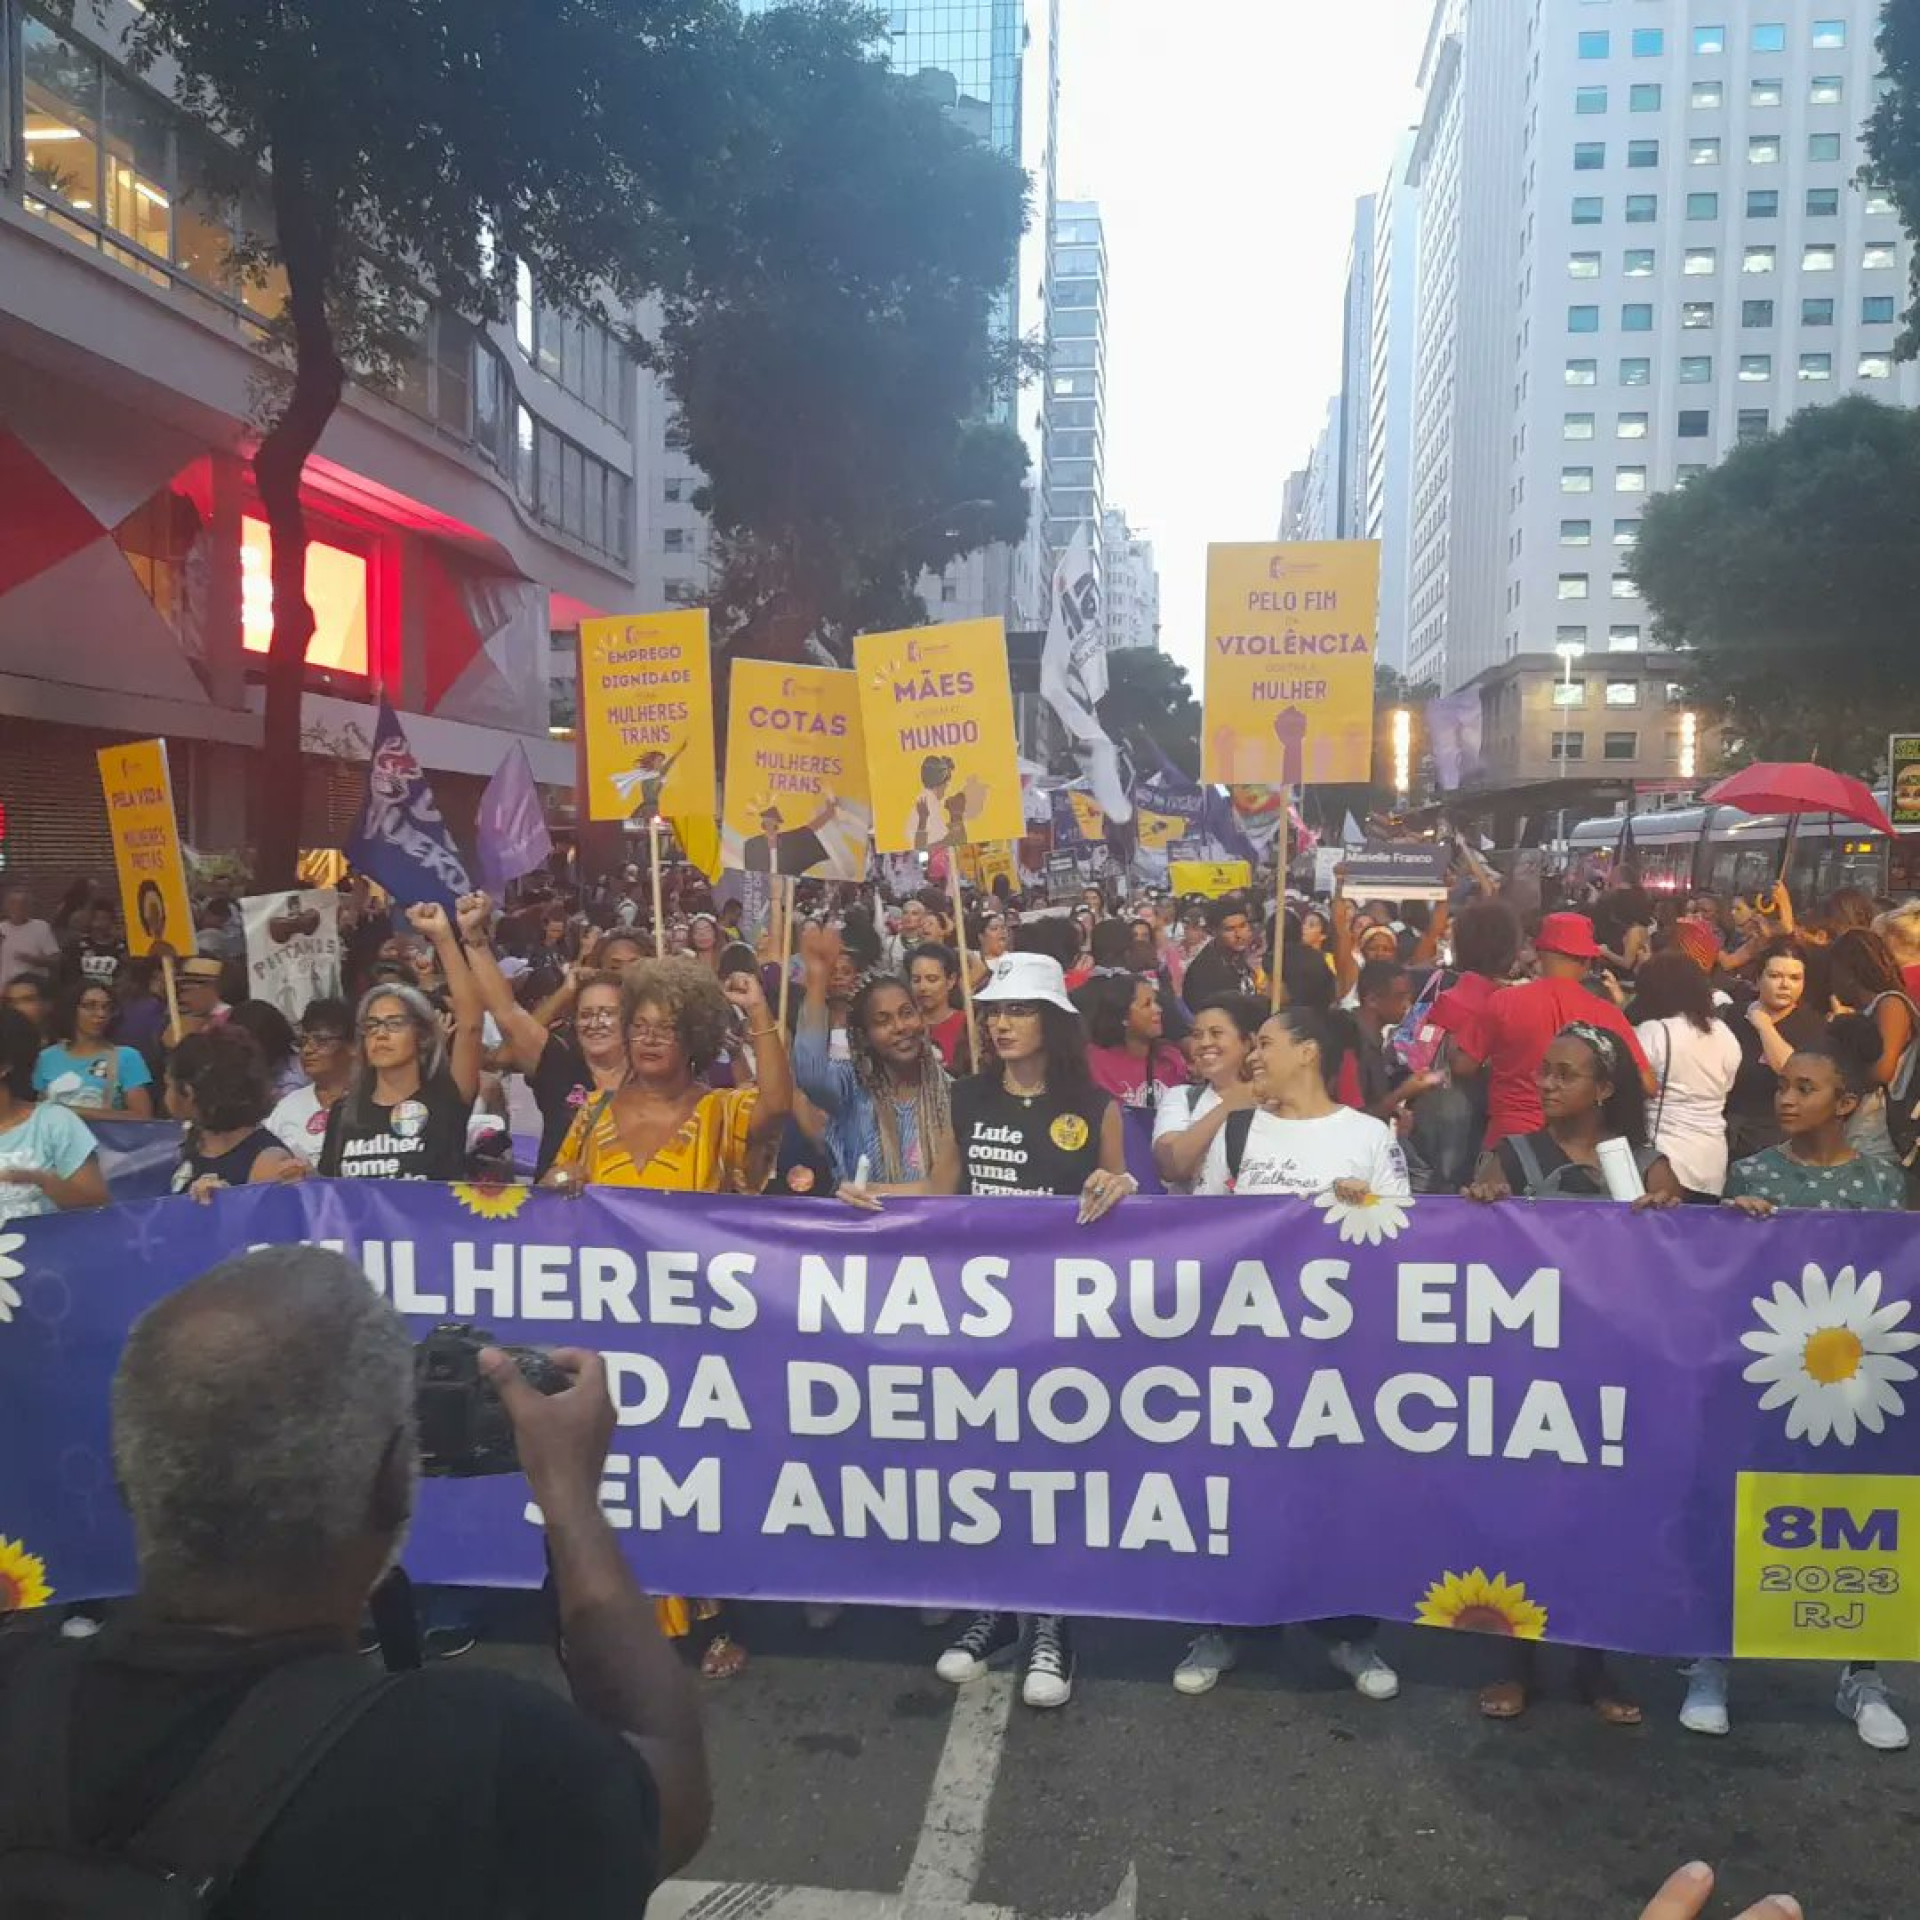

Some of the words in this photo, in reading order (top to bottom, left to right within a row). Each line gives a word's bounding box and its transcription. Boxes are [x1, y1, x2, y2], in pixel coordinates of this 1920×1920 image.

[1248, 591, 1297, 611] PELO
[1304, 590, 1337, 611] FIM
[1216, 628, 1369, 655] VIOLÊNCIA
[607, 646, 682, 664] EMPREGO
[602, 669, 691, 689] DIGNIDADE
[893, 669, 975, 703] MÃES
[1252, 680, 1327, 701] MULHER
[608, 702, 688, 725] MULHERES
[749, 705, 847, 736] COTAS
[620, 725, 671, 745] TRANS
[899, 719, 978, 752] MUNDO
[755, 749, 843, 775] MULHERES
[768, 772, 822, 794] TRANS
[1393, 852, 1433, 864] Franco
[970, 1121, 1024, 1144] Lute
[342, 1133, 426, 1158] Mulher,
[968, 1144, 1029, 1164] como
[968, 1163, 1018, 1182] uma
[247, 1238, 758, 1330] LHERES
[797, 1253, 1014, 1337] NAS
[1053, 1256, 1354, 1340] RUAS
[1397, 1262, 1561, 1349] EM
[599, 1350, 752, 1430] DA
[787, 1359, 1627, 1469] DEMOCRACIA!
[523, 1453, 721, 1533] EM
[760, 1460, 1231, 1556] ANISTIA!
[1761, 1505, 1900, 1552] 8M
[1760, 1564, 1900, 1594] 2023
[1794, 1601, 1864, 1628] RJ
